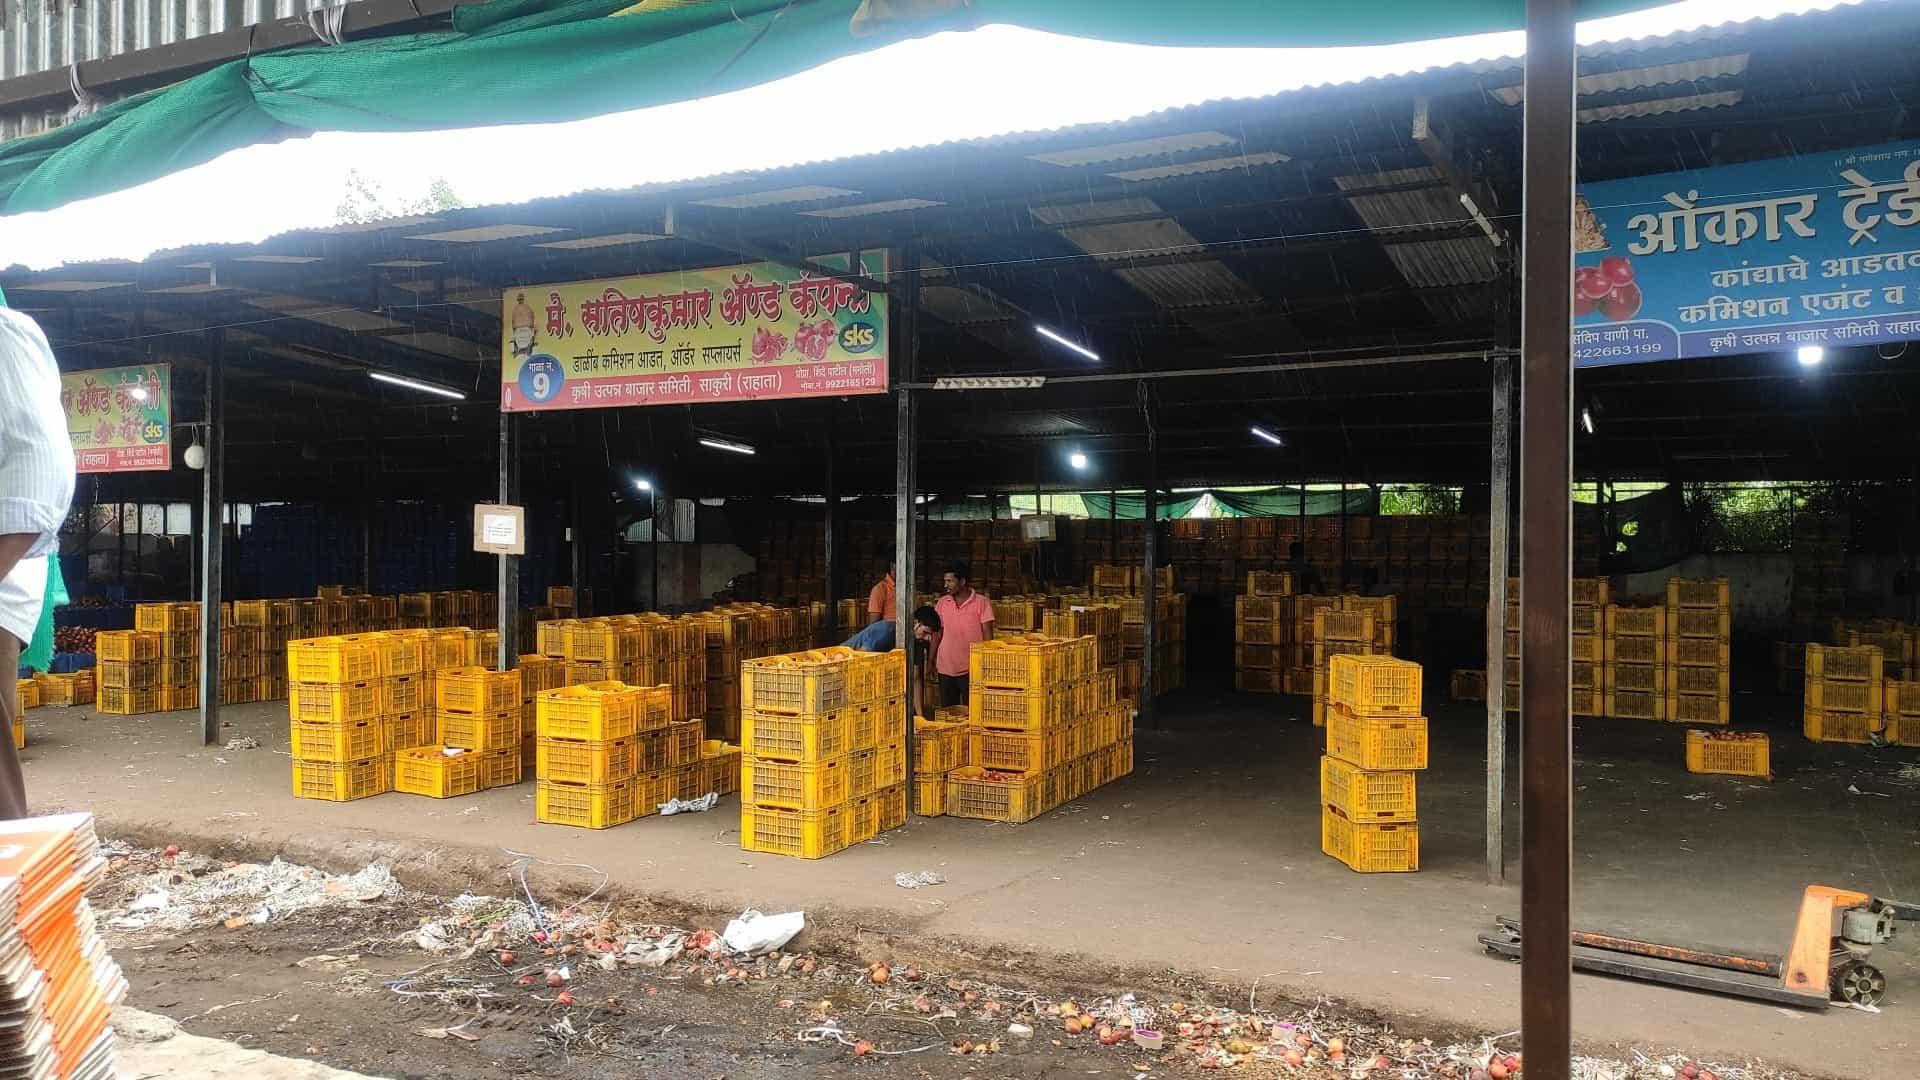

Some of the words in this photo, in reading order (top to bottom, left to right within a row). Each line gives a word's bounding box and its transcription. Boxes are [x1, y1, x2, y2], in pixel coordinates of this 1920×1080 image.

[1627, 189, 1818, 256] ओंकार
[1678, 295, 1790, 324] कमिशन
[1800, 283, 1872, 316] एजंट
[1709, 332, 1737, 352] कृषी
[1742, 333, 1781, 348] उत्पन्न
[1834, 320, 1880, 339] समिती
[602, 347, 634, 371] कमिशन
[638, 350, 667, 371] आडत,
[670, 342, 696, 367] ऑर्डर
[702, 338, 742, 364] सप्लायर्स
[533, 373, 550, 400] 9
[570, 381, 591, 403] कृषी
[594, 383, 622, 399] उत्पन्न
[699, 372, 732, 397] साकुरी
[737, 370, 782, 393] (राहाता)
